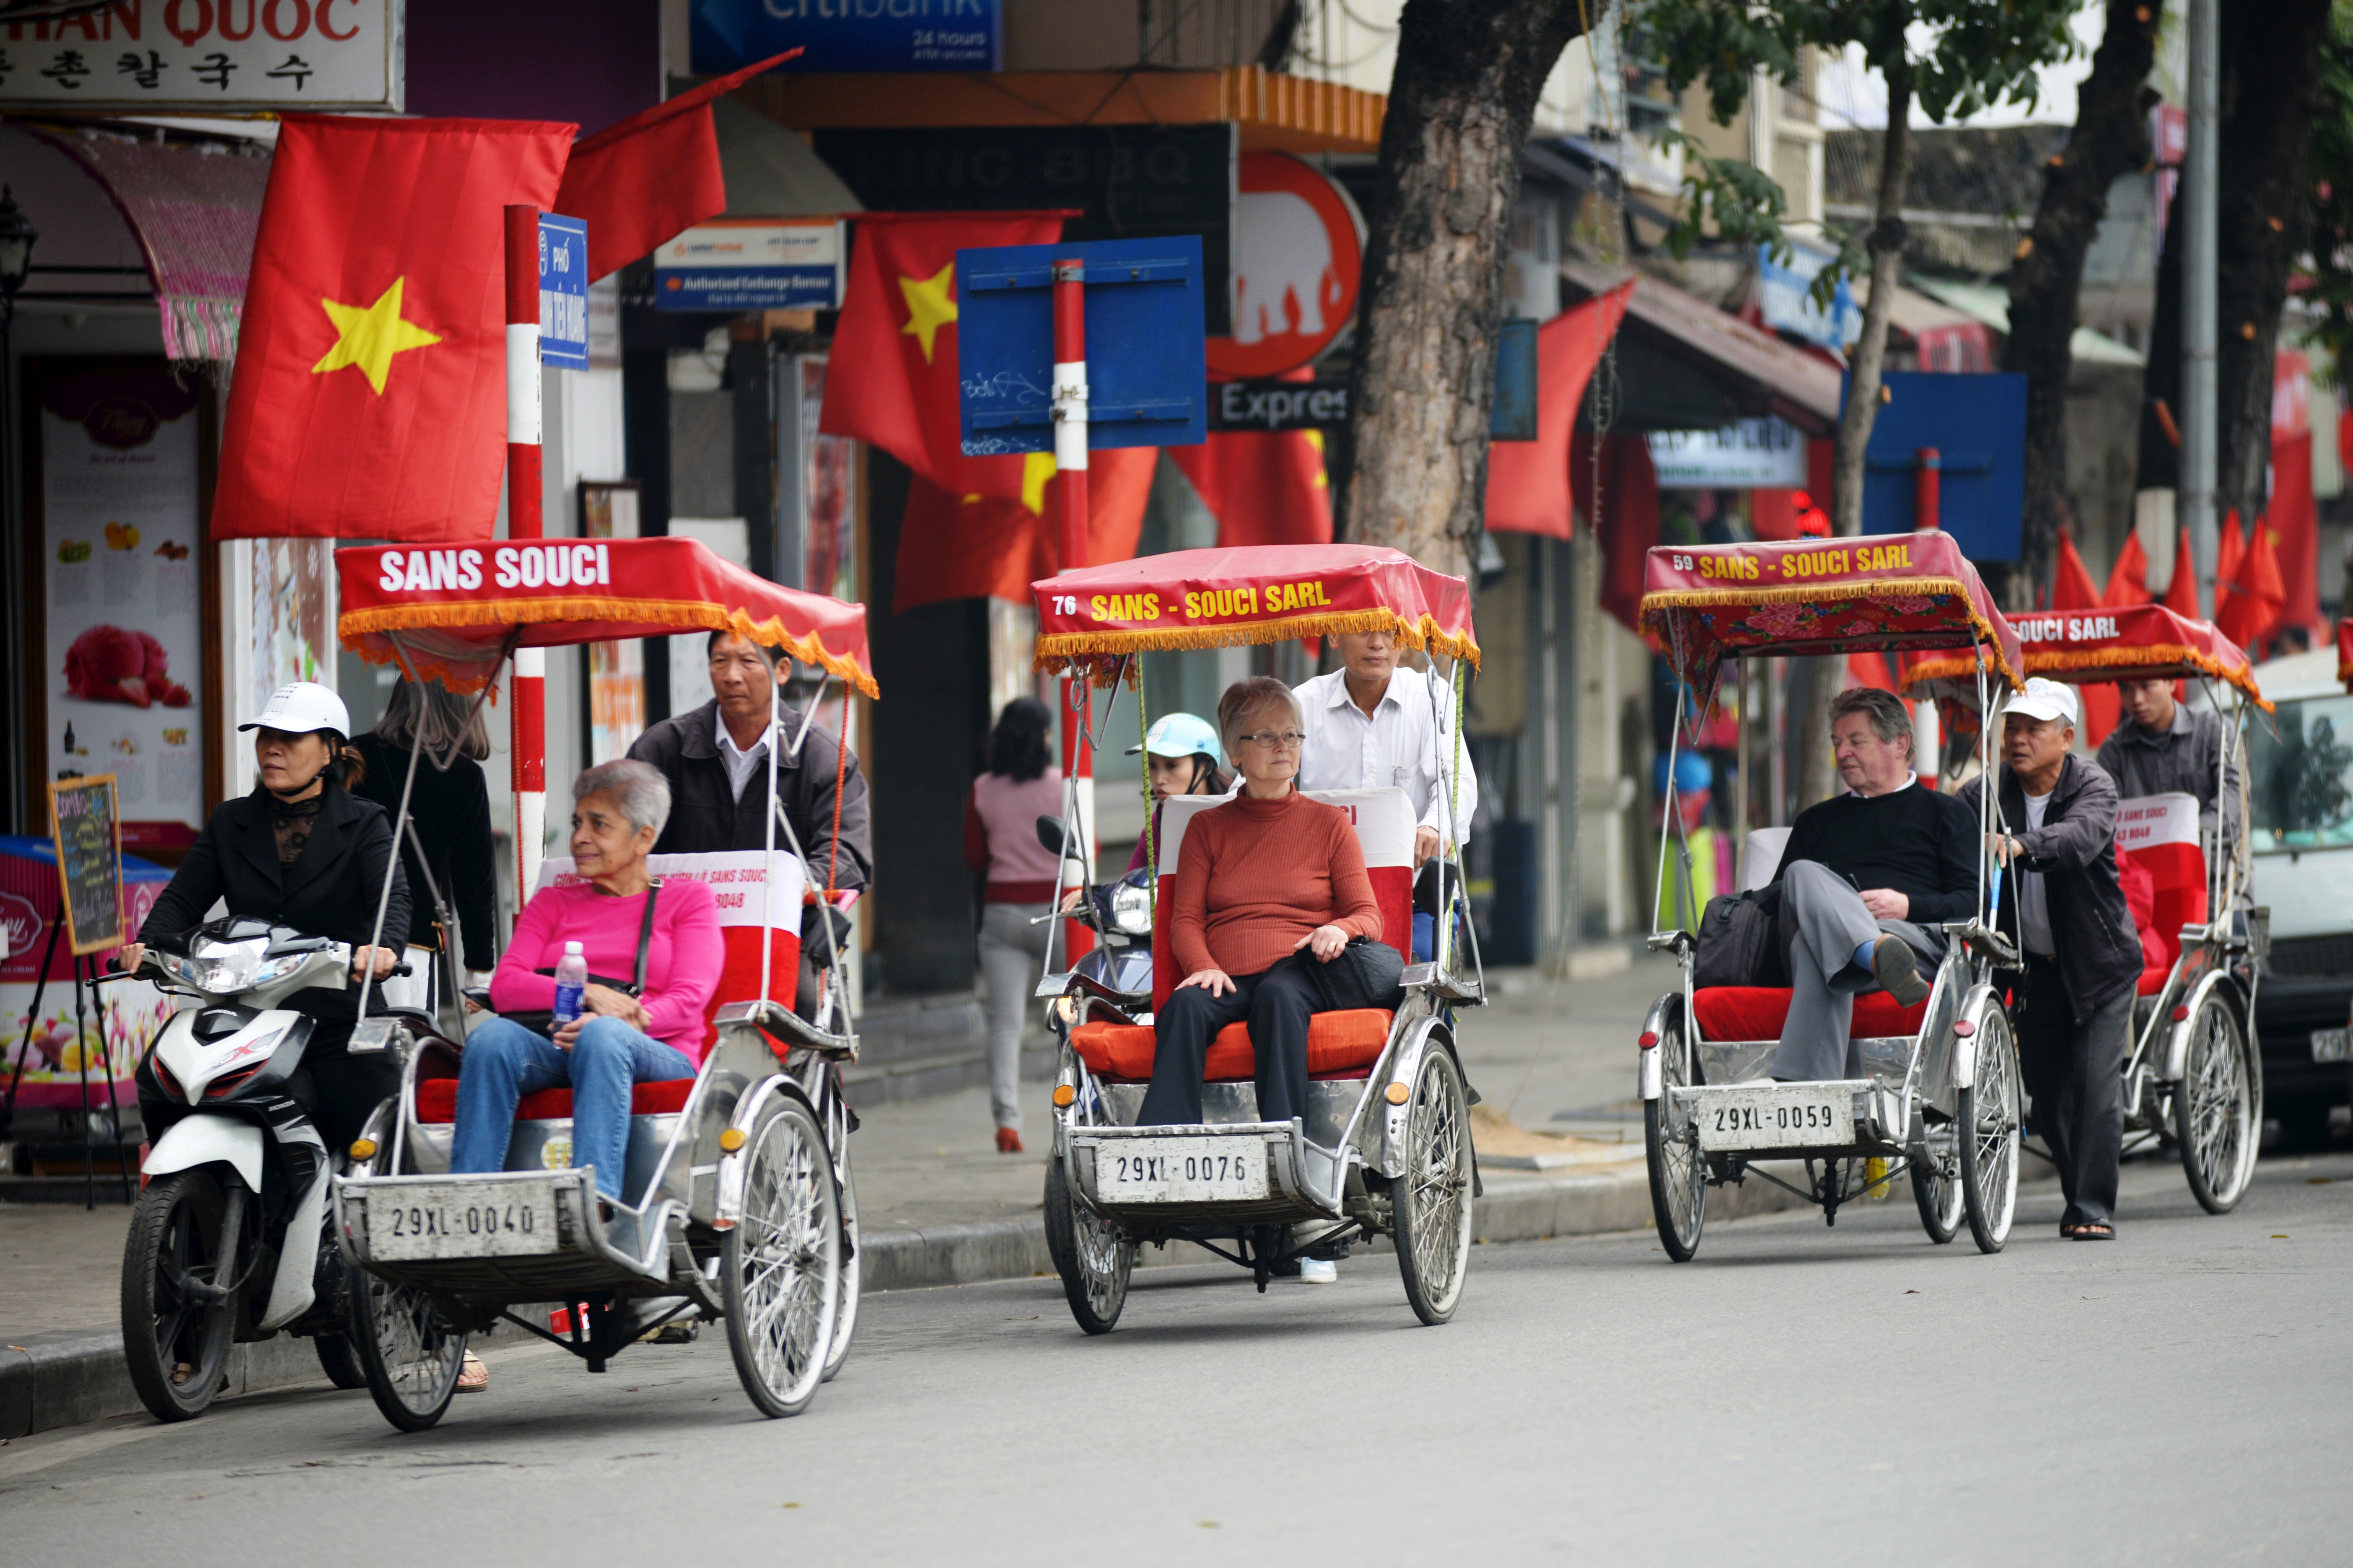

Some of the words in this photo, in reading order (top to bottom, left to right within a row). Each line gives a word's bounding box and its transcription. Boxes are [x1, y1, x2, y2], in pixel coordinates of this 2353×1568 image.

[913, 29, 933, 47] 24
[938, 30, 986, 46] hours
[553, 236, 570, 273] PHỐ
[379, 549, 483, 592] SANS
[495, 544, 610, 588] SOUCI
[1673, 555, 1694, 571] 59
[1699, 556, 1759, 580] SANS
[1782, 550, 1850, 578] SOUCI
[1857, 544, 1913, 572] SARL
[1052, 595, 1076, 616] 76
[1091, 593, 1160, 622] SANS
[1185, 587, 1258, 619] SOUCI
[1265, 581, 1332, 613] SARL
[2068, 616, 2121, 642] SARL
[2124, 809, 2143, 822] SANS
[2145, 806, 2168, 820] SOUCI
[2129, 826, 2151, 840] 8048
[708, 869, 736, 883] SANS
[268, 1100, 295, 1112] HONDA
[1714, 1105, 1833, 1131] 29XL-0059
